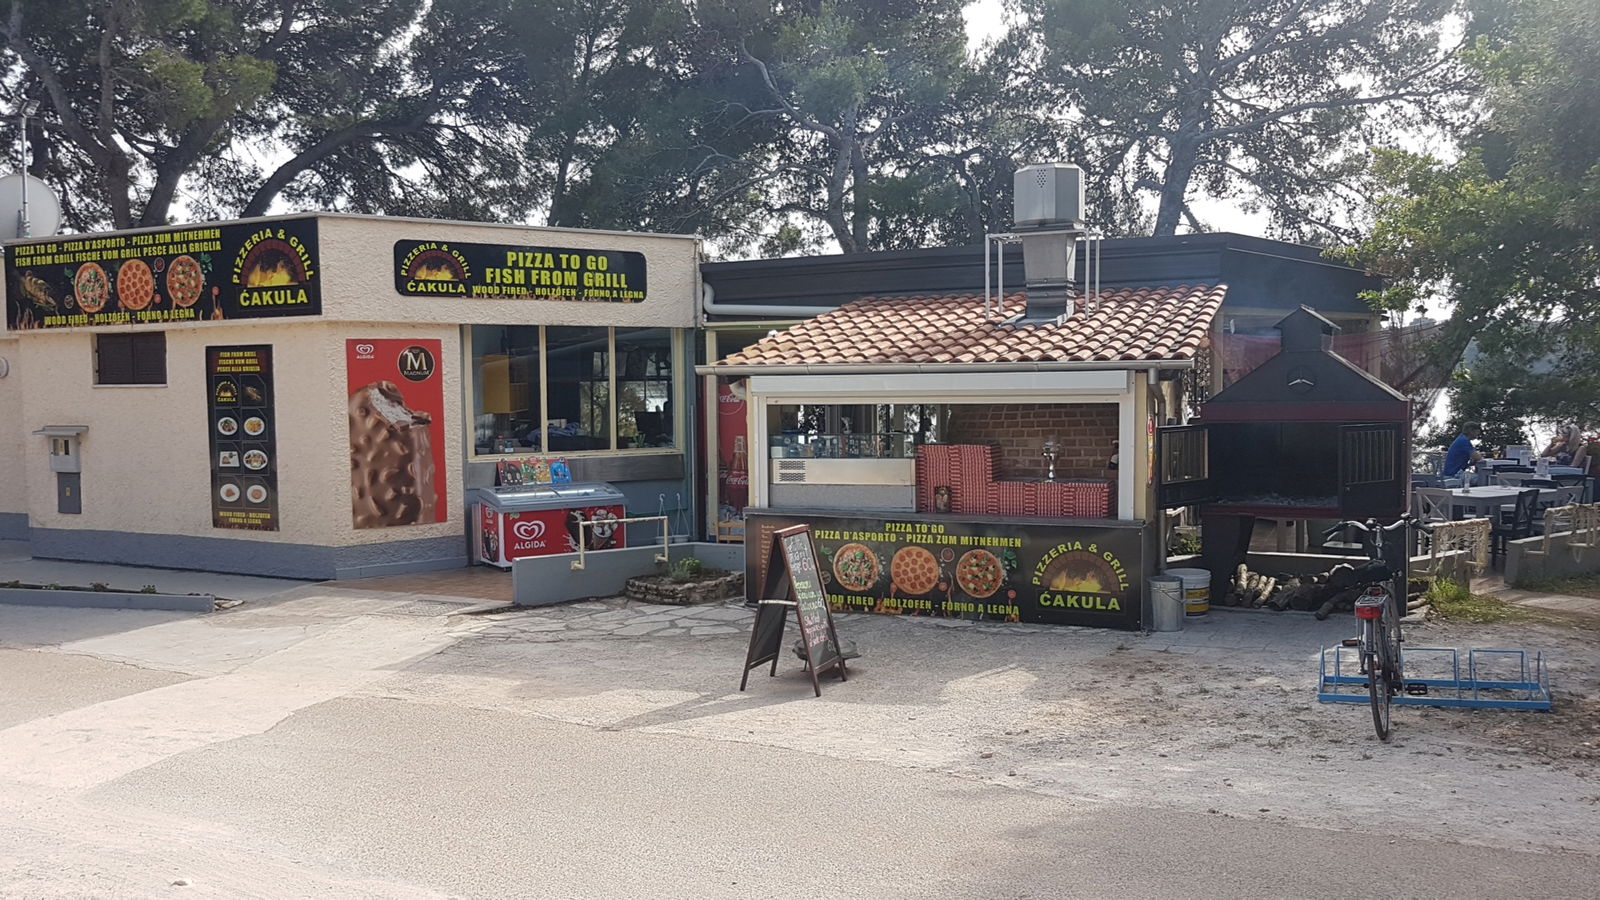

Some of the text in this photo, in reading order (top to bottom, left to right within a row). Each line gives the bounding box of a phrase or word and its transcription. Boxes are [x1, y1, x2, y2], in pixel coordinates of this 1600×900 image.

[15, 247, 34, 256] PIZZA
[36, 246, 45, 254] TO
[47, 244, 57, 252] GO
[64, 242, 83, 251] PIZZA
[85, 238, 125, 250] D'ASPORTO
[133, 236, 153, 245] PIZZA
[155, 234, 171, 243] ZUM
[174, 229, 220, 242] MITNEHMEN
[16, 241, 221, 267] FISH FROM GRILL FISCHE VOM GRILL PESCE ALLA GRIGLIA
[233, 229, 313, 284] PIZZERIA & GRILL
[401, 243, 437, 276] PIZZERIA
[452, 250, 471, 279] GRILL
[507, 252, 607, 270] PIZZA TO GO
[486, 268, 628, 288] FISH FROM GRILL
[472, 285, 499, 294] WOOD
[503, 286, 527, 295] FIRED
[536, 287, 576, 296] HOLZOFEN
[585, 289, 610, 298] FORNO
[613, 290, 618, 298] A
[620, 291, 643, 299] LEGNA
[44, 316, 67, 326] WOOD
[68, 314, 88, 324] FIRED
[95, 312, 130, 323] HOLZOFEN
[137, 310, 162, 320] FORNO
[163, 310, 168, 319] A
[171, 308, 195, 319] LEGNA
[886, 523, 944, 533] PIZZA TO GO
[514, 541, 545, 550] ALGIDA
[815, 530, 840, 539] PIZZA
[844, 531, 896, 542] D'ASPORTO
[906, 534, 933, 544] PIZZA
[937, 535, 957, 544] ZUM
[961, 536, 1022, 547] MITNEHMEN
[1033, 541, 1129, 591] PIZZERIA & GRILL
[826, 594, 844, 603] OOD
[847, 596, 874, 605] FIRED
[884, 598, 931, 609] HOLZOFEN
[942, 601, 974, 612] FORNO
[978, 604, 984, 613] A
[988, 604, 1020, 614] LEGNA
